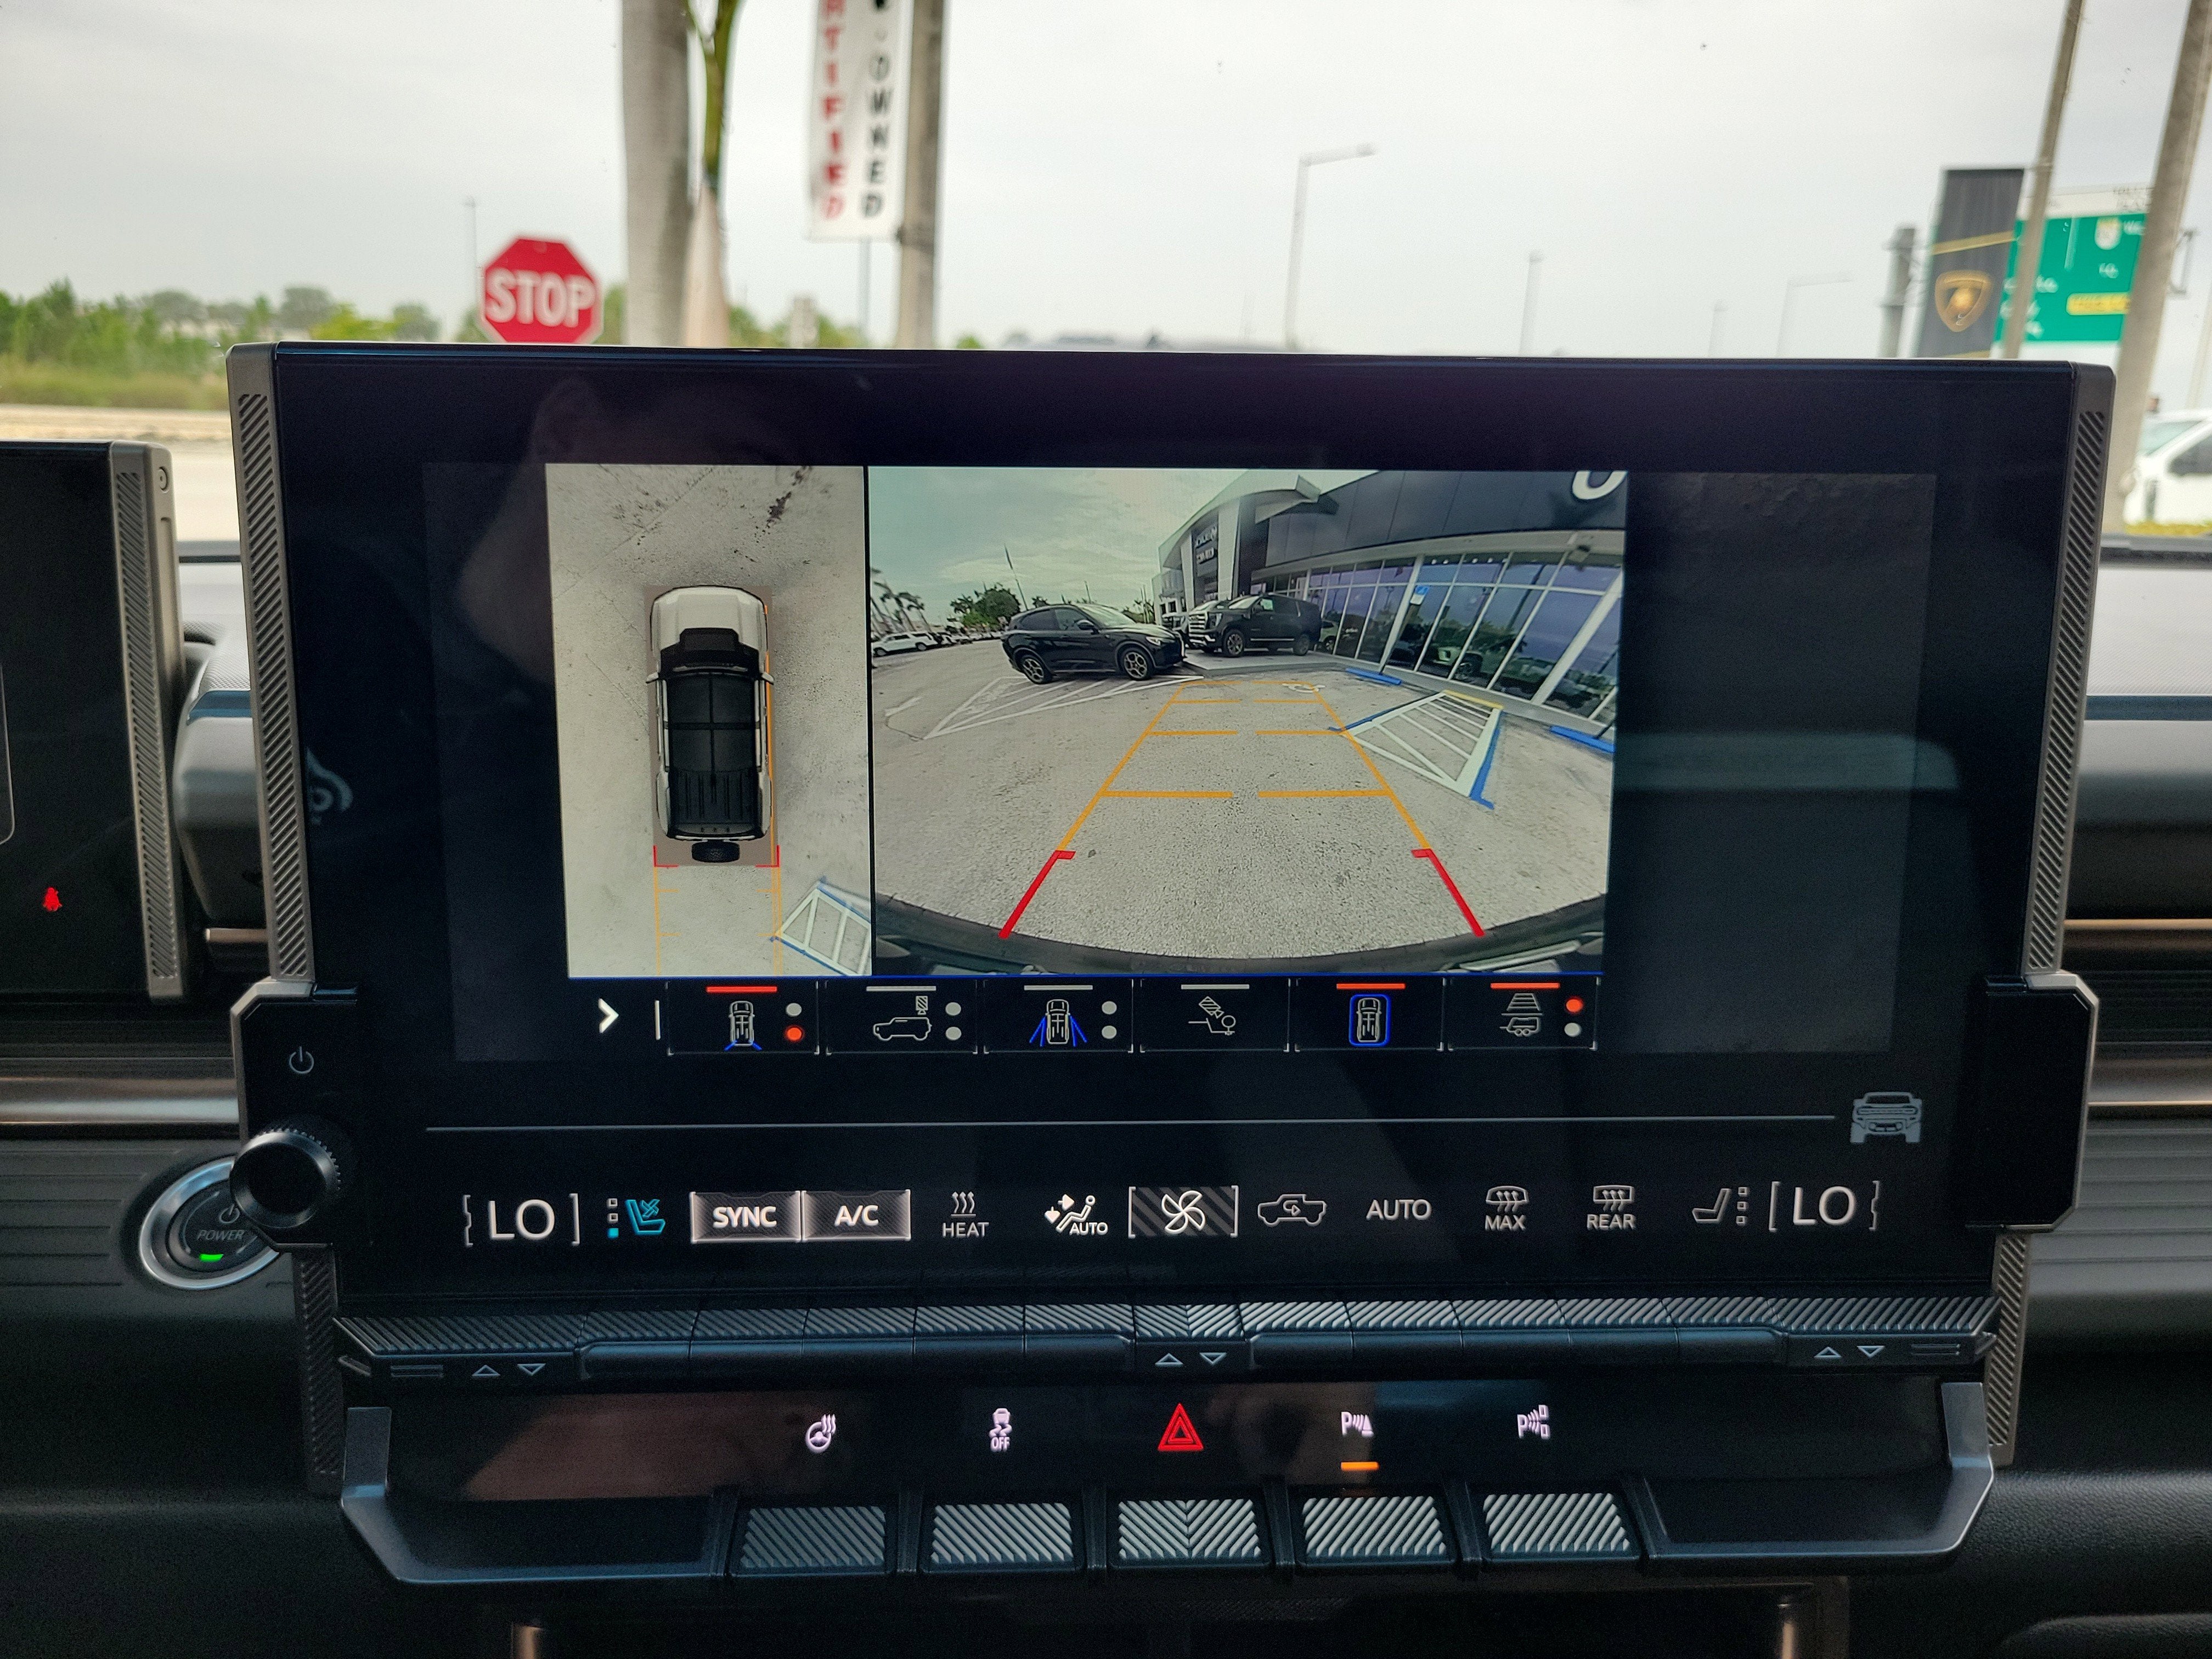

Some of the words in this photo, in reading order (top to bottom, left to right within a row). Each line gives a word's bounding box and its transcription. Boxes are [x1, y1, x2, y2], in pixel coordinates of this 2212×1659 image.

[485, 268, 596, 328] STOP
[834, 1204, 879, 1227] A/C
[1366, 1199, 1432, 1221] AUTO
[1793, 1186, 1857, 1226] LO
[489, 1199, 555, 1240] LO
[713, 1206, 777, 1228] SYNC
[1485, 1214, 1526, 1231] MAX
[1587, 1214, 1635, 1231] REAR
[196, 1229, 245, 1241] POWER
[942, 1222, 989, 1238] HEAT
[1070, 1221, 1108, 1235] AUTO
[990, 1436, 1010, 1452] OFF
